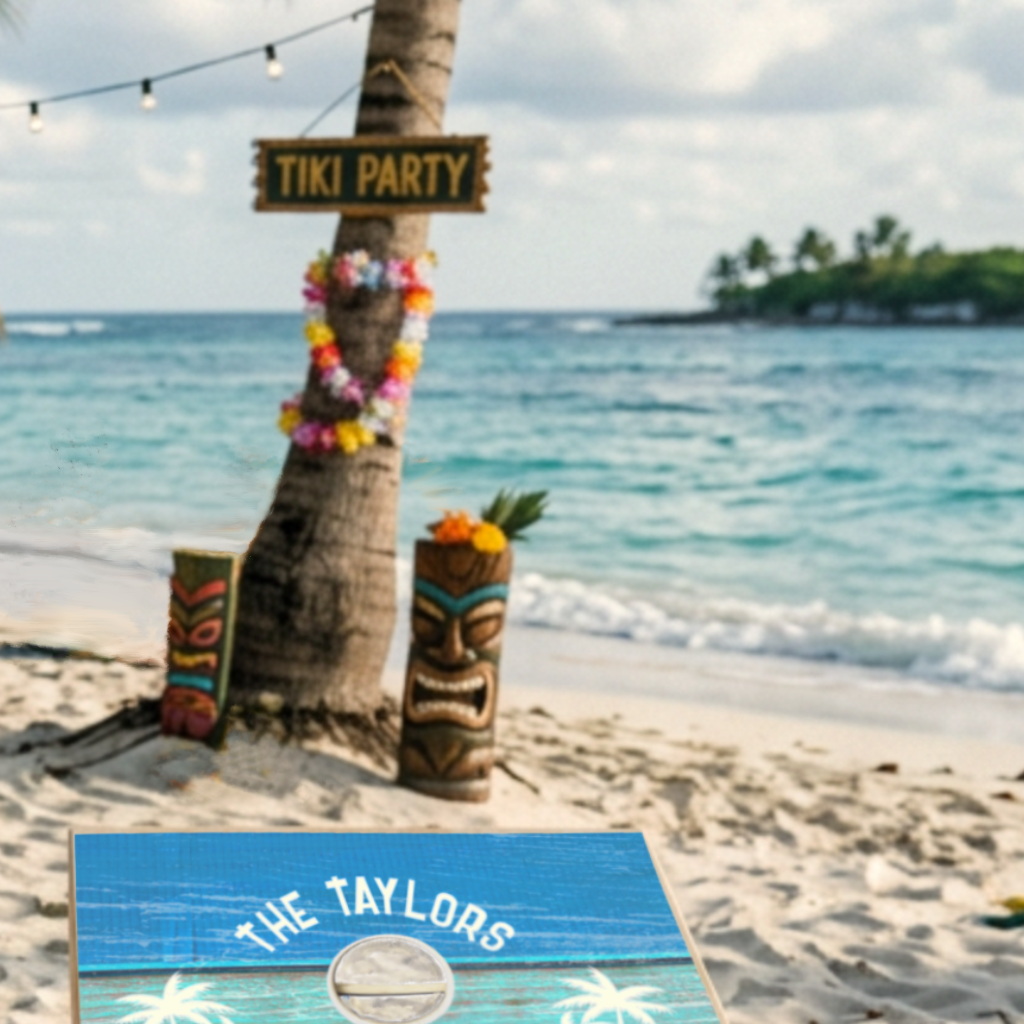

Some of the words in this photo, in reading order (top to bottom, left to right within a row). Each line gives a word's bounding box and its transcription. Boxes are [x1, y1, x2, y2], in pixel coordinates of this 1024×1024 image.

[275, 155, 343, 196] TIKI
[357, 153, 469, 197] PARTY
[234, 890, 318, 952] THE
[325, 876, 516, 952] TAYLORS
